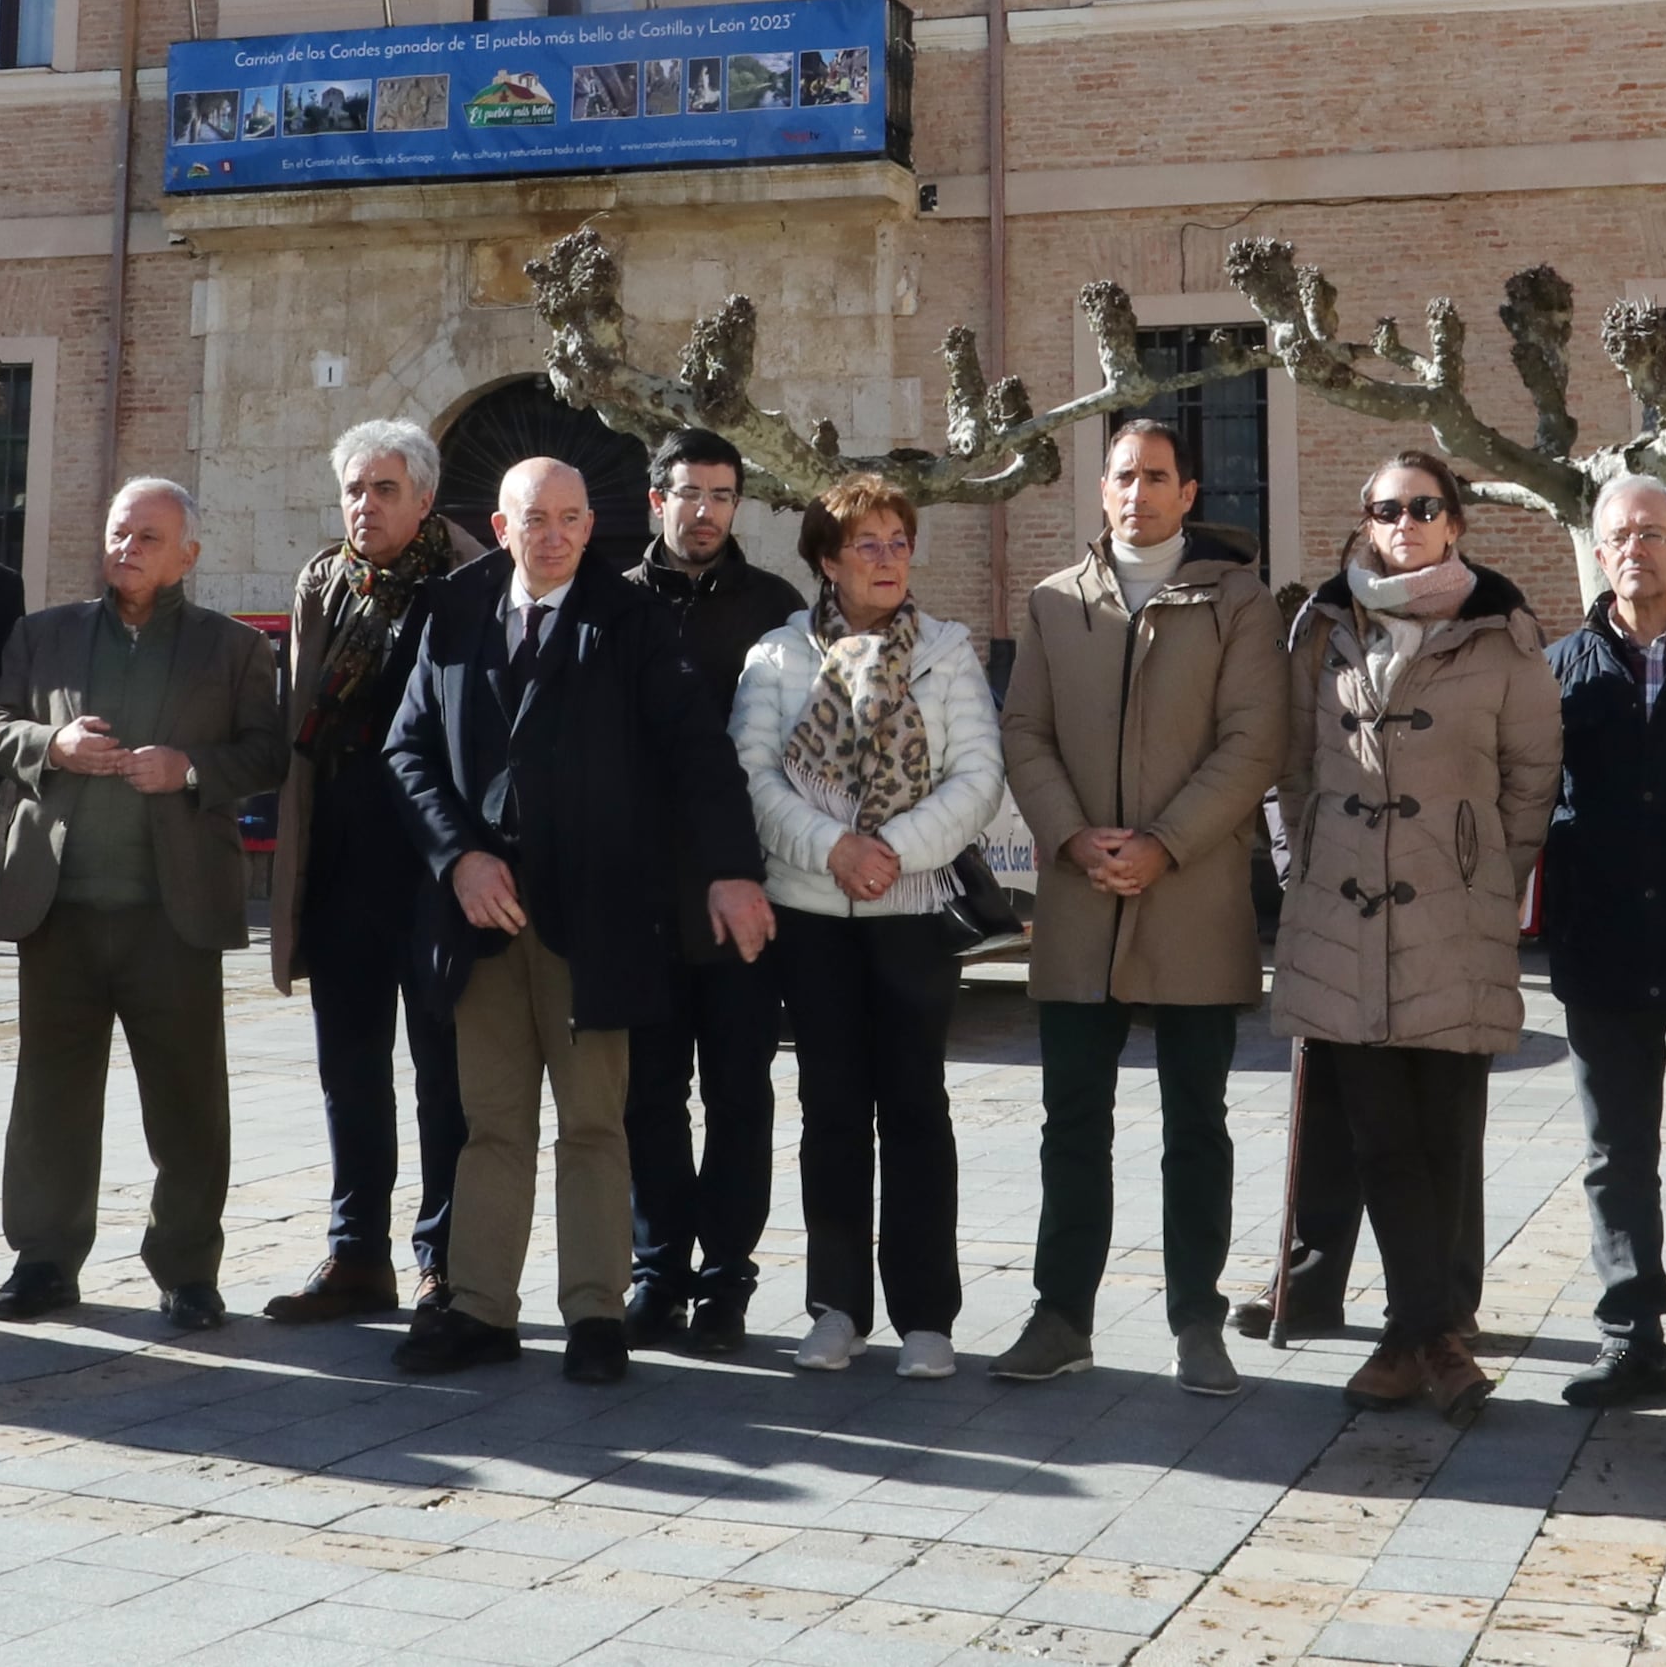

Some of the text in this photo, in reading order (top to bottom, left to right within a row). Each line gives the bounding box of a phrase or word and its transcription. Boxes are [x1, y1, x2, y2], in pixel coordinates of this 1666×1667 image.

[234, 51, 283, 67] Carrión
[287, 46, 303, 62] de
[307, 44, 325, 59] los
[329, 42, 380, 59] Condes
[385, 37, 444, 58] ganador
[448, 35, 465, 51] de
[493, 30, 541, 51] pueblo
[545, 32, 575, 45] más
[579, 25, 613, 43] bello
[618, 23, 635, 40] de
[639, 19, 693, 38] Castilla
[697, 25, 705, 38] y
[709, 18, 745, 33] León
